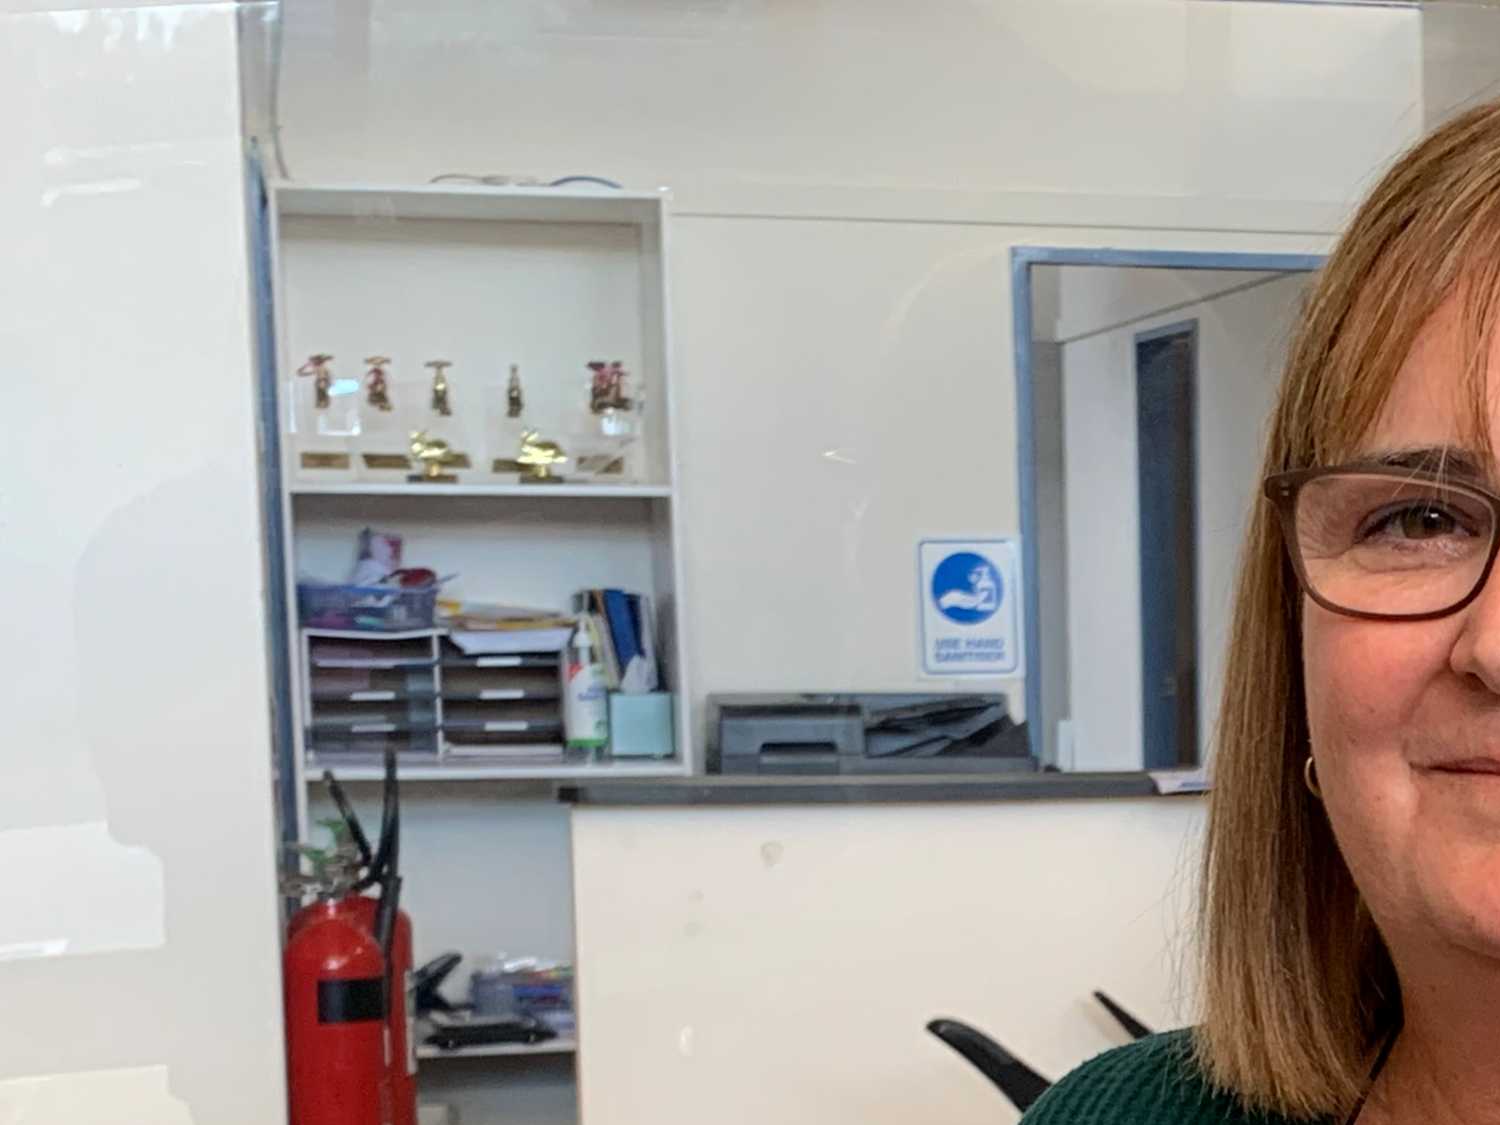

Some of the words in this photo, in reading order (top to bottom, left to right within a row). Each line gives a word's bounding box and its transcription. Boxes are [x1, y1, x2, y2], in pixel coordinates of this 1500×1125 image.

[934, 637, 960, 650] USE
[965, 637, 1004, 650] HAND
[934, 651, 1005, 663] SANITISER
